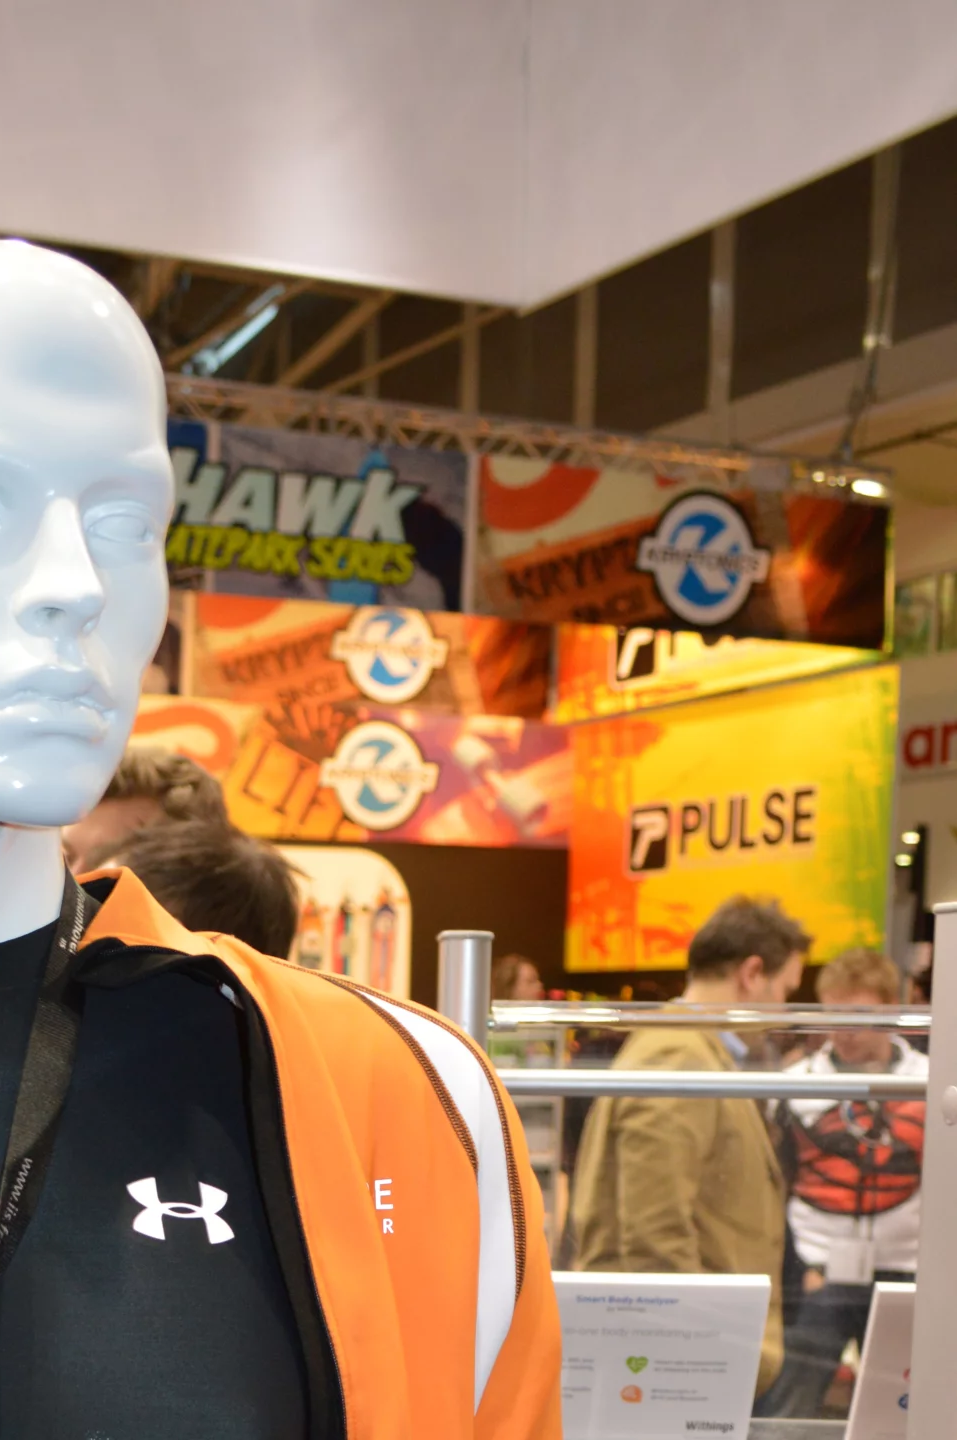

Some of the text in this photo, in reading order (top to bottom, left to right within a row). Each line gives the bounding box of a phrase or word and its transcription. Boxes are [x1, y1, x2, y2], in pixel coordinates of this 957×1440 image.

[172, 447, 426, 543] HAWK
[679, 788, 816, 854] PULSE
[685, 1420, 736, 1434] Withings
